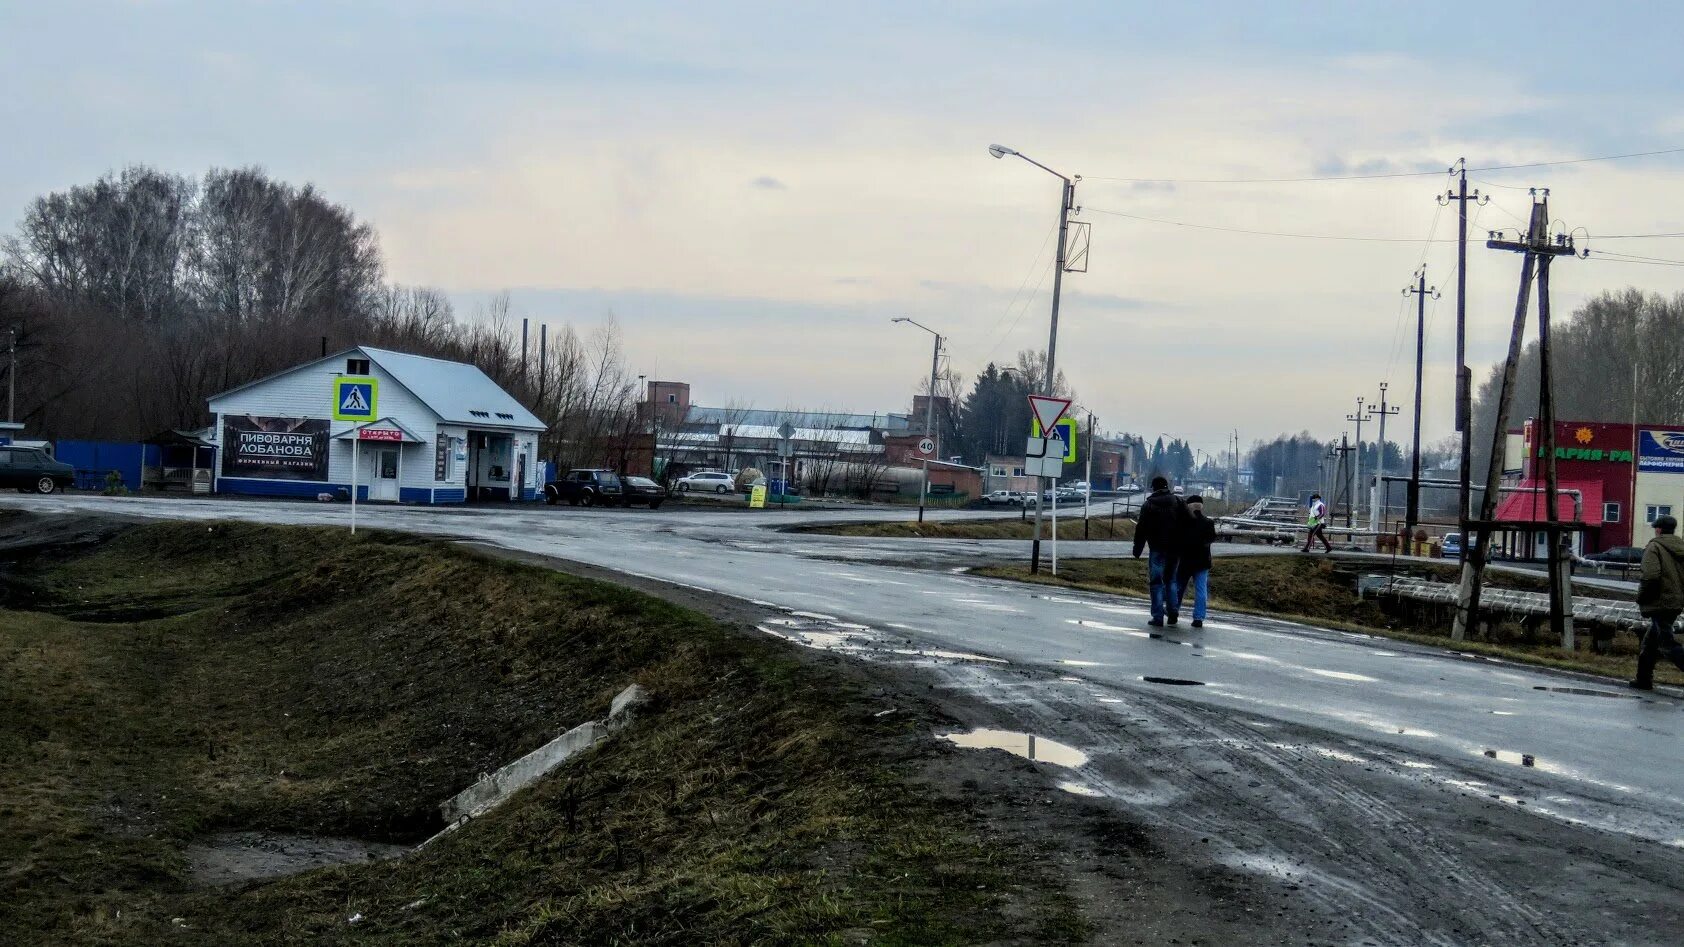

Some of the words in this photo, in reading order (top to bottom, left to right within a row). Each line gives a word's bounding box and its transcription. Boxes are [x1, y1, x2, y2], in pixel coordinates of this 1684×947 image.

[240, 433, 313, 445] ПИВОВАРНЯ
[239, 443, 313, 456] ЛОБАНОВА
[920, 442, 933, 451] 40
